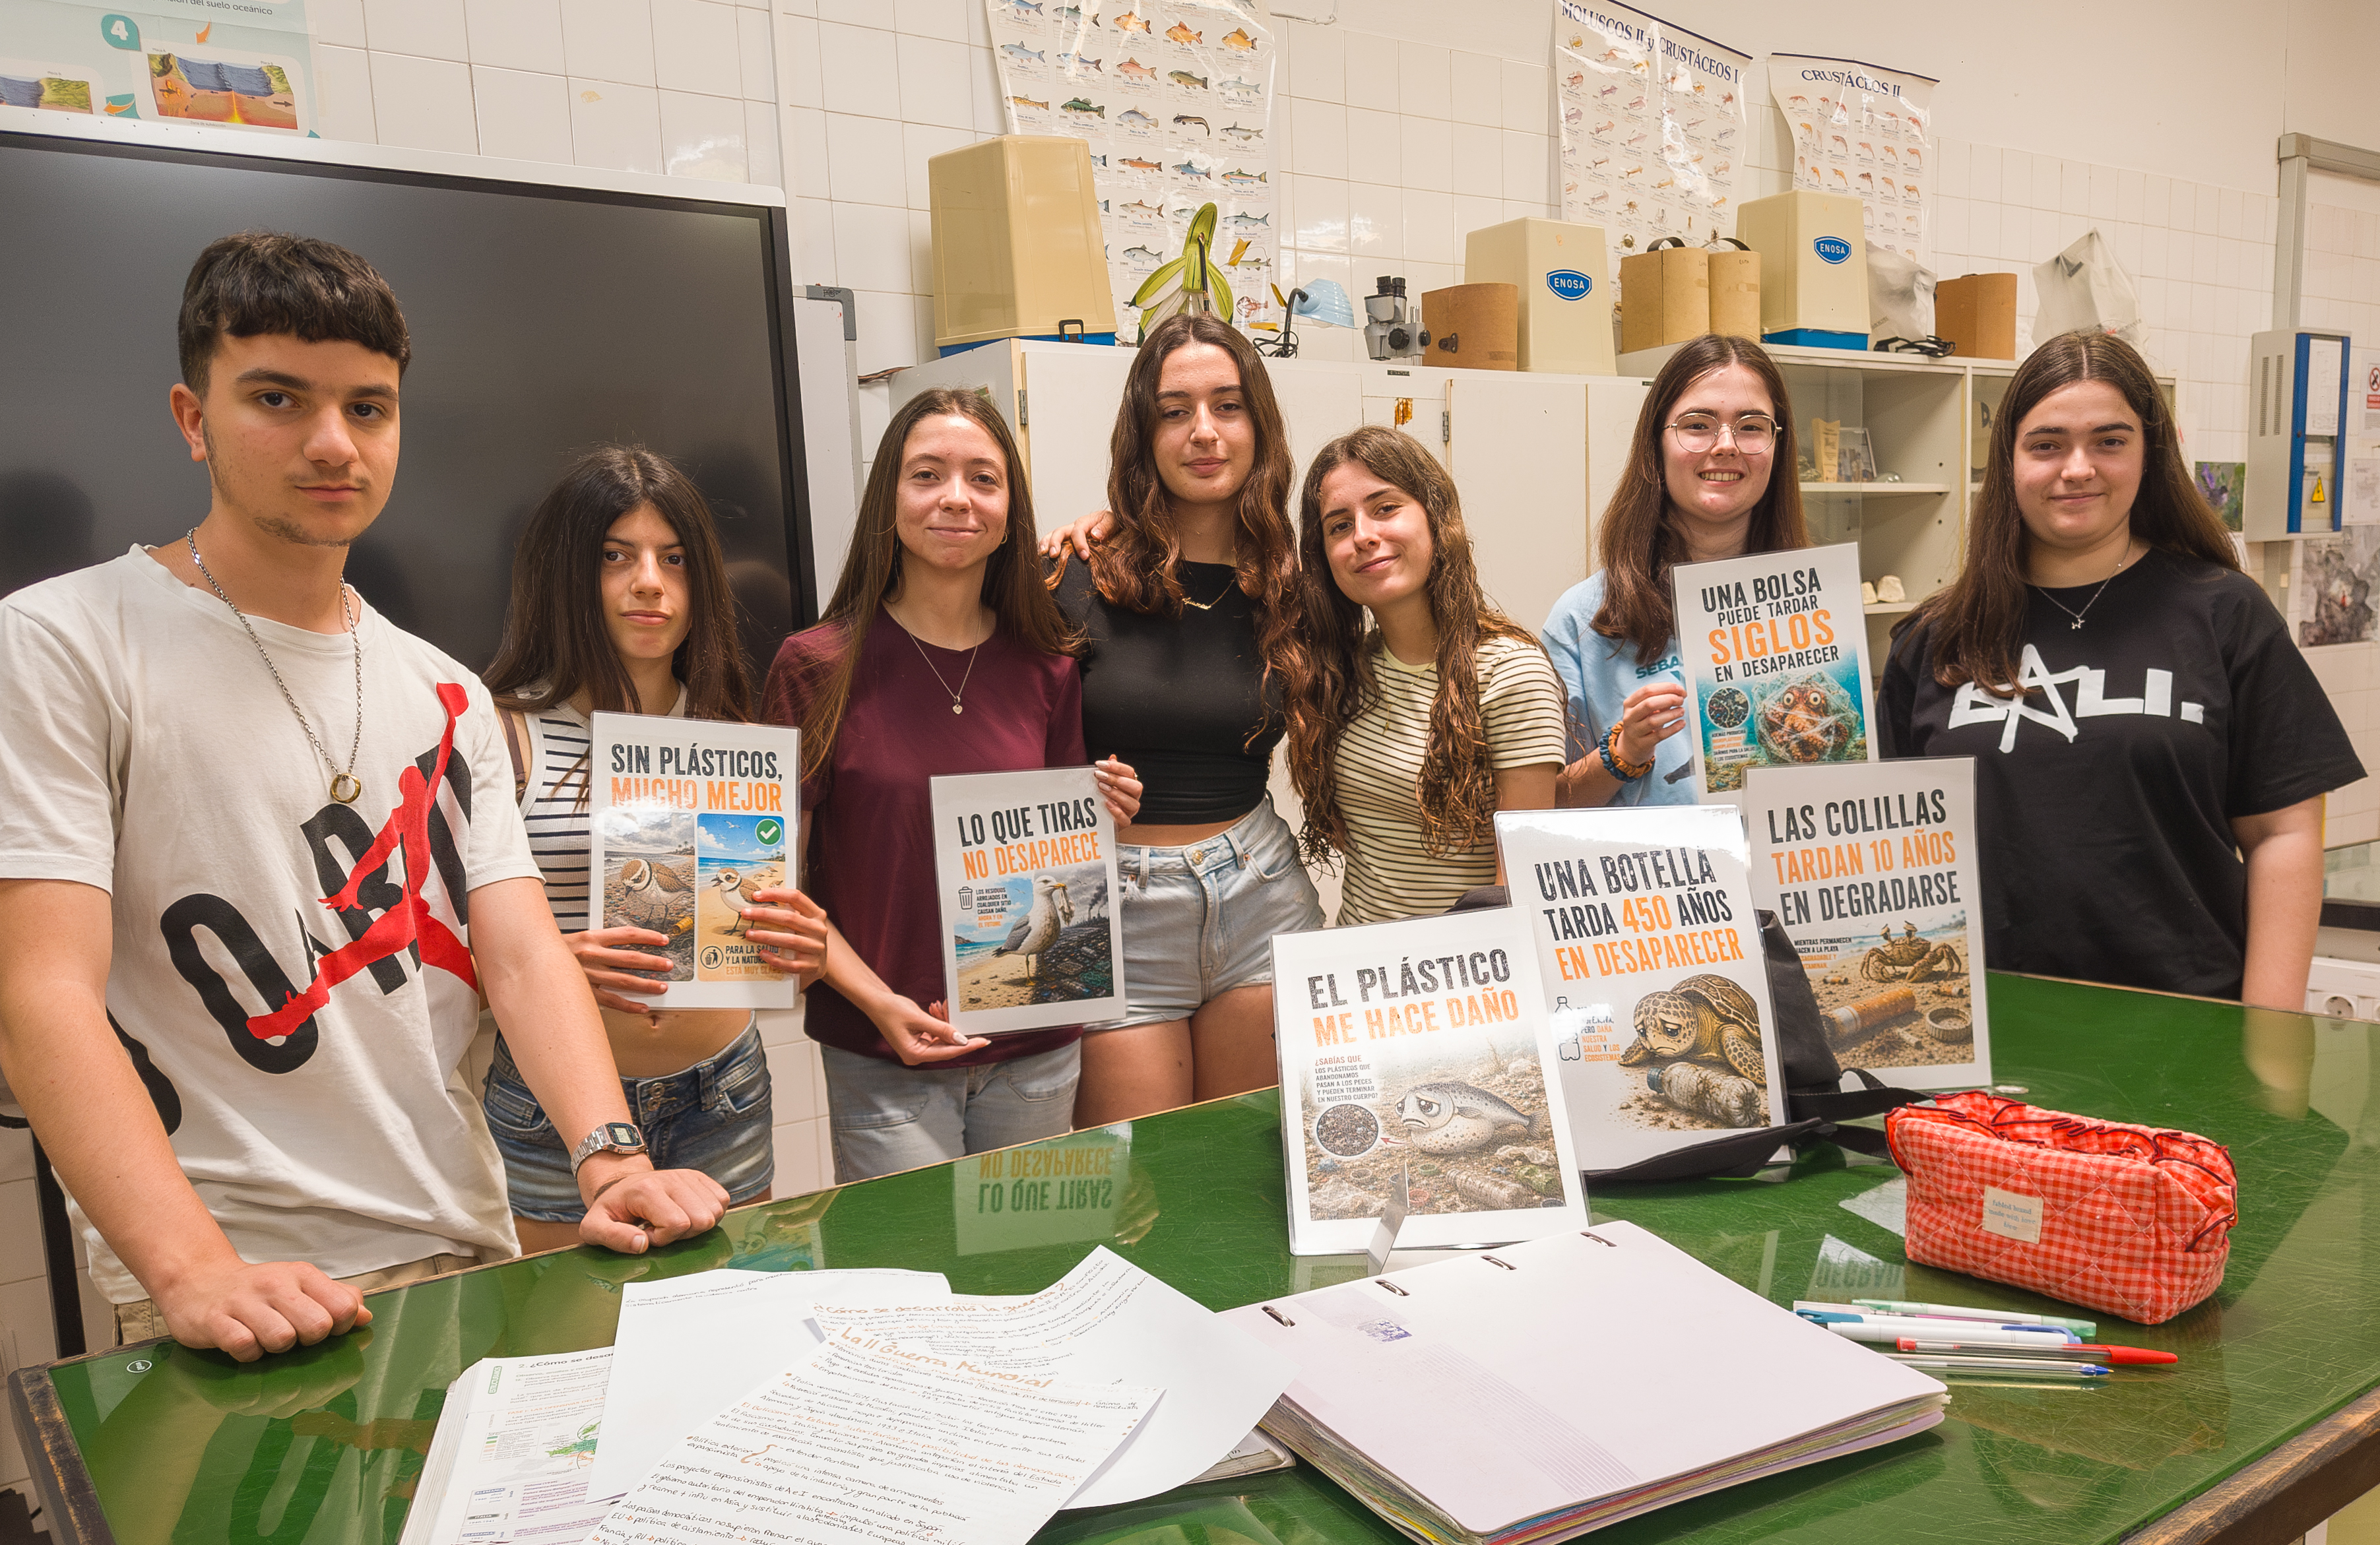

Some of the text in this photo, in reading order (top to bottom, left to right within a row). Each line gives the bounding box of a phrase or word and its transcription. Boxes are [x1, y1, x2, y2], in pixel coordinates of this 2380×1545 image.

[207, 1, 230, 10] suelo
[233, 4, 273, 16] oceánico
[110, 20, 129, 41] 4
[1562, 2, 1632, 40] MOLUSCOS
[1636, 28, 1644, 46] II
[1648, 38, 1654, 51] y
[1659, 37, 1731, 81] CRUSTÁCEOS
[1893, 84, 1901, 97] II
[1820, 244, 1846, 255] ENOSA
[1554, 277, 1585, 290] ENOSA
[1701, 568, 1822, 612] UNA BOLSA
[1718, 595, 1818, 627] PUEDE TARDAR
[1708, 610, 1834, 665] SIGLOS
[1715, 645, 1839, 682] EN DESAPARECER
[611, 743, 783, 781] SIN PLÁSTICOS,
[611, 777, 783, 811] MUCHO MEJOR
[957, 797, 1097, 847] LO QUE TIRAS
[1768, 789, 1946, 844] LAS COLILLAS
[962, 831, 1102, 881] NO DESAPARECE
[1535, 846, 1717, 901] UNA BOTELLA
[1771, 829, 1956, 885] TARDAN 10 AÑOS
[1543, 887, 1733, 941] TARDA 450 AÑOS
[1780, 871, 1961, 926] EN DEGRADARSE
[726, 945, 755, 954] PARA LA
[1555, 928, 1744, 981] EN DESAPARECER
[1307, 948, 1510, 1009] EL PLÁSTICO
[1312, 986, 1519, 1047] ME HACE DAÑO
[1315, 1056, 1345, 1066] ¿SABÍAS
[1316, 1072, 1359, 1081] ABANDONAMOS
[982, 1304, 1000, 1313] la
[841, 1327, 862, 1345] La
[880, 1342, 947, 1368] Guerra
[660, 1460, 676, 1468] Los
[676, 1464, 712, 1474] proyectos
